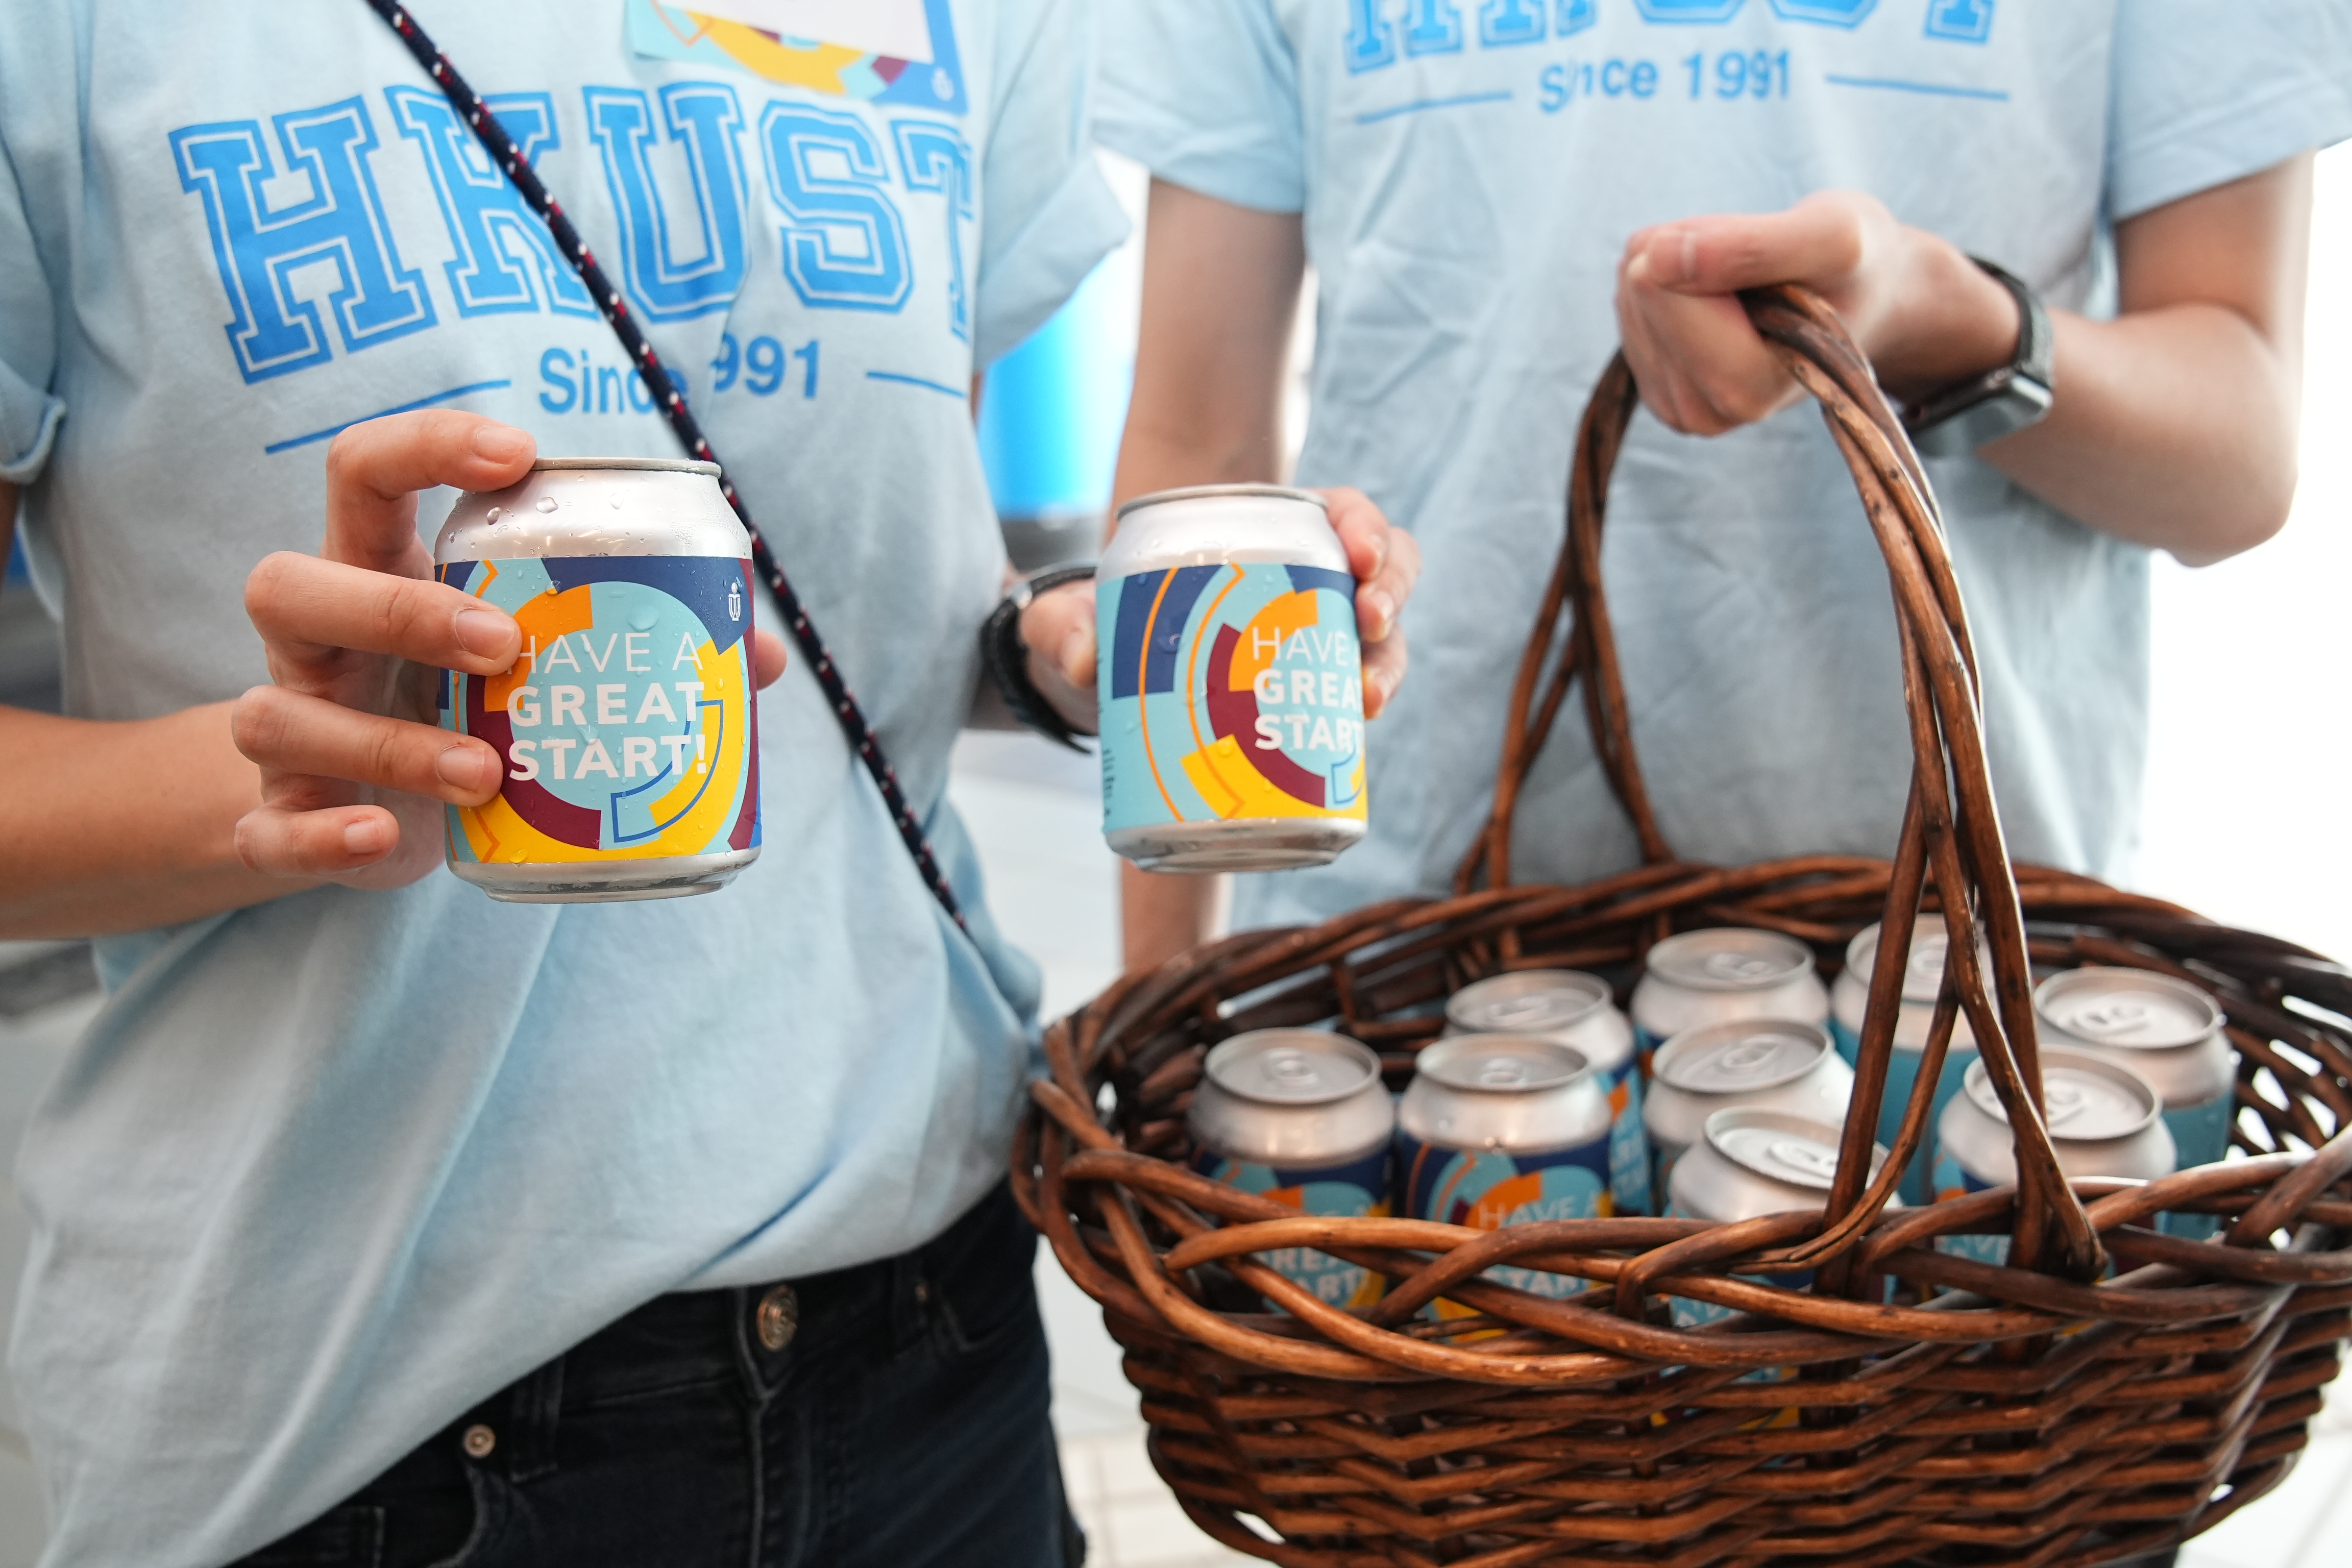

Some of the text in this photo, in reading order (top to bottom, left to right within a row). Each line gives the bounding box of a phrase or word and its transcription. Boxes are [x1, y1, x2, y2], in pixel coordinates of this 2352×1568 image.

[1540, 50, 1792, 113] Snce 1991
[507, 631, 704, 675] HAVE A
[1252, 626, 1350, 667] HAVE
[506, 681, 705, 728] GREAT
[509, 733, 707, 782] START!
